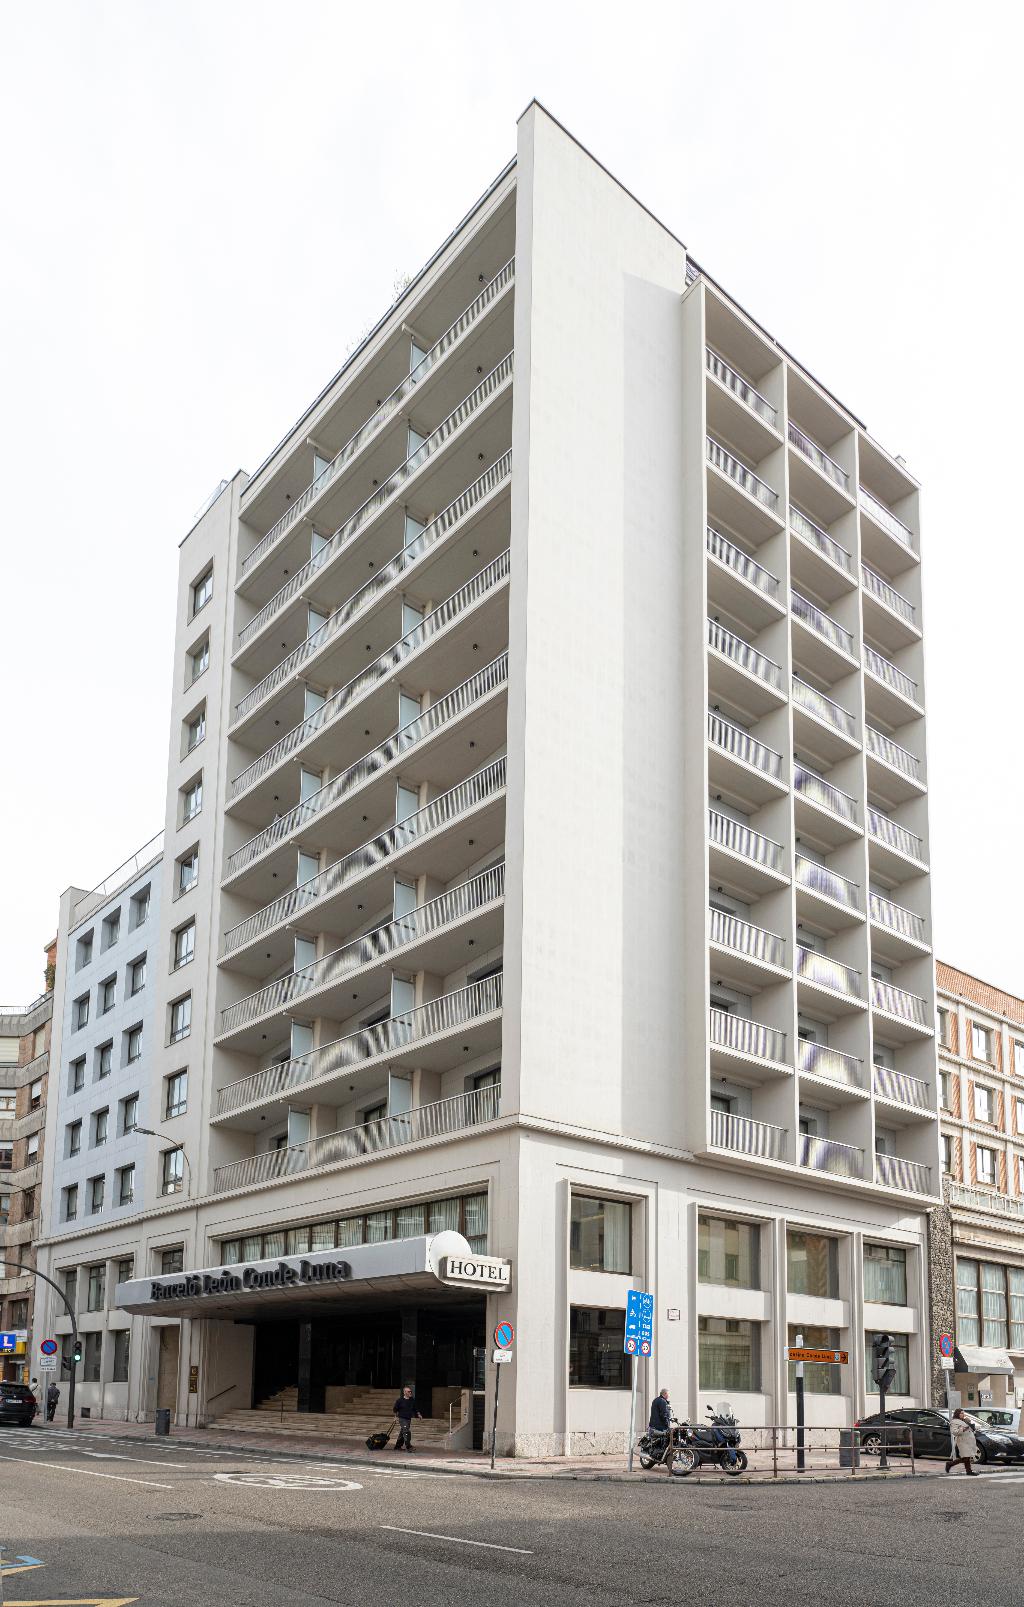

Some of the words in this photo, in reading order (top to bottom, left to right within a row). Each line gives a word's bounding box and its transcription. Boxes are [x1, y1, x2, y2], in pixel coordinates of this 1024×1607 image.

[150, 1274, 200, 1299] Barceló
[202, 1270, 242, 1294] León
[243, 1262, 299, 1288] Conde
[300, 1260, 352, 1281] Luna
[450, 1260, 507, 1280] HOTEL
